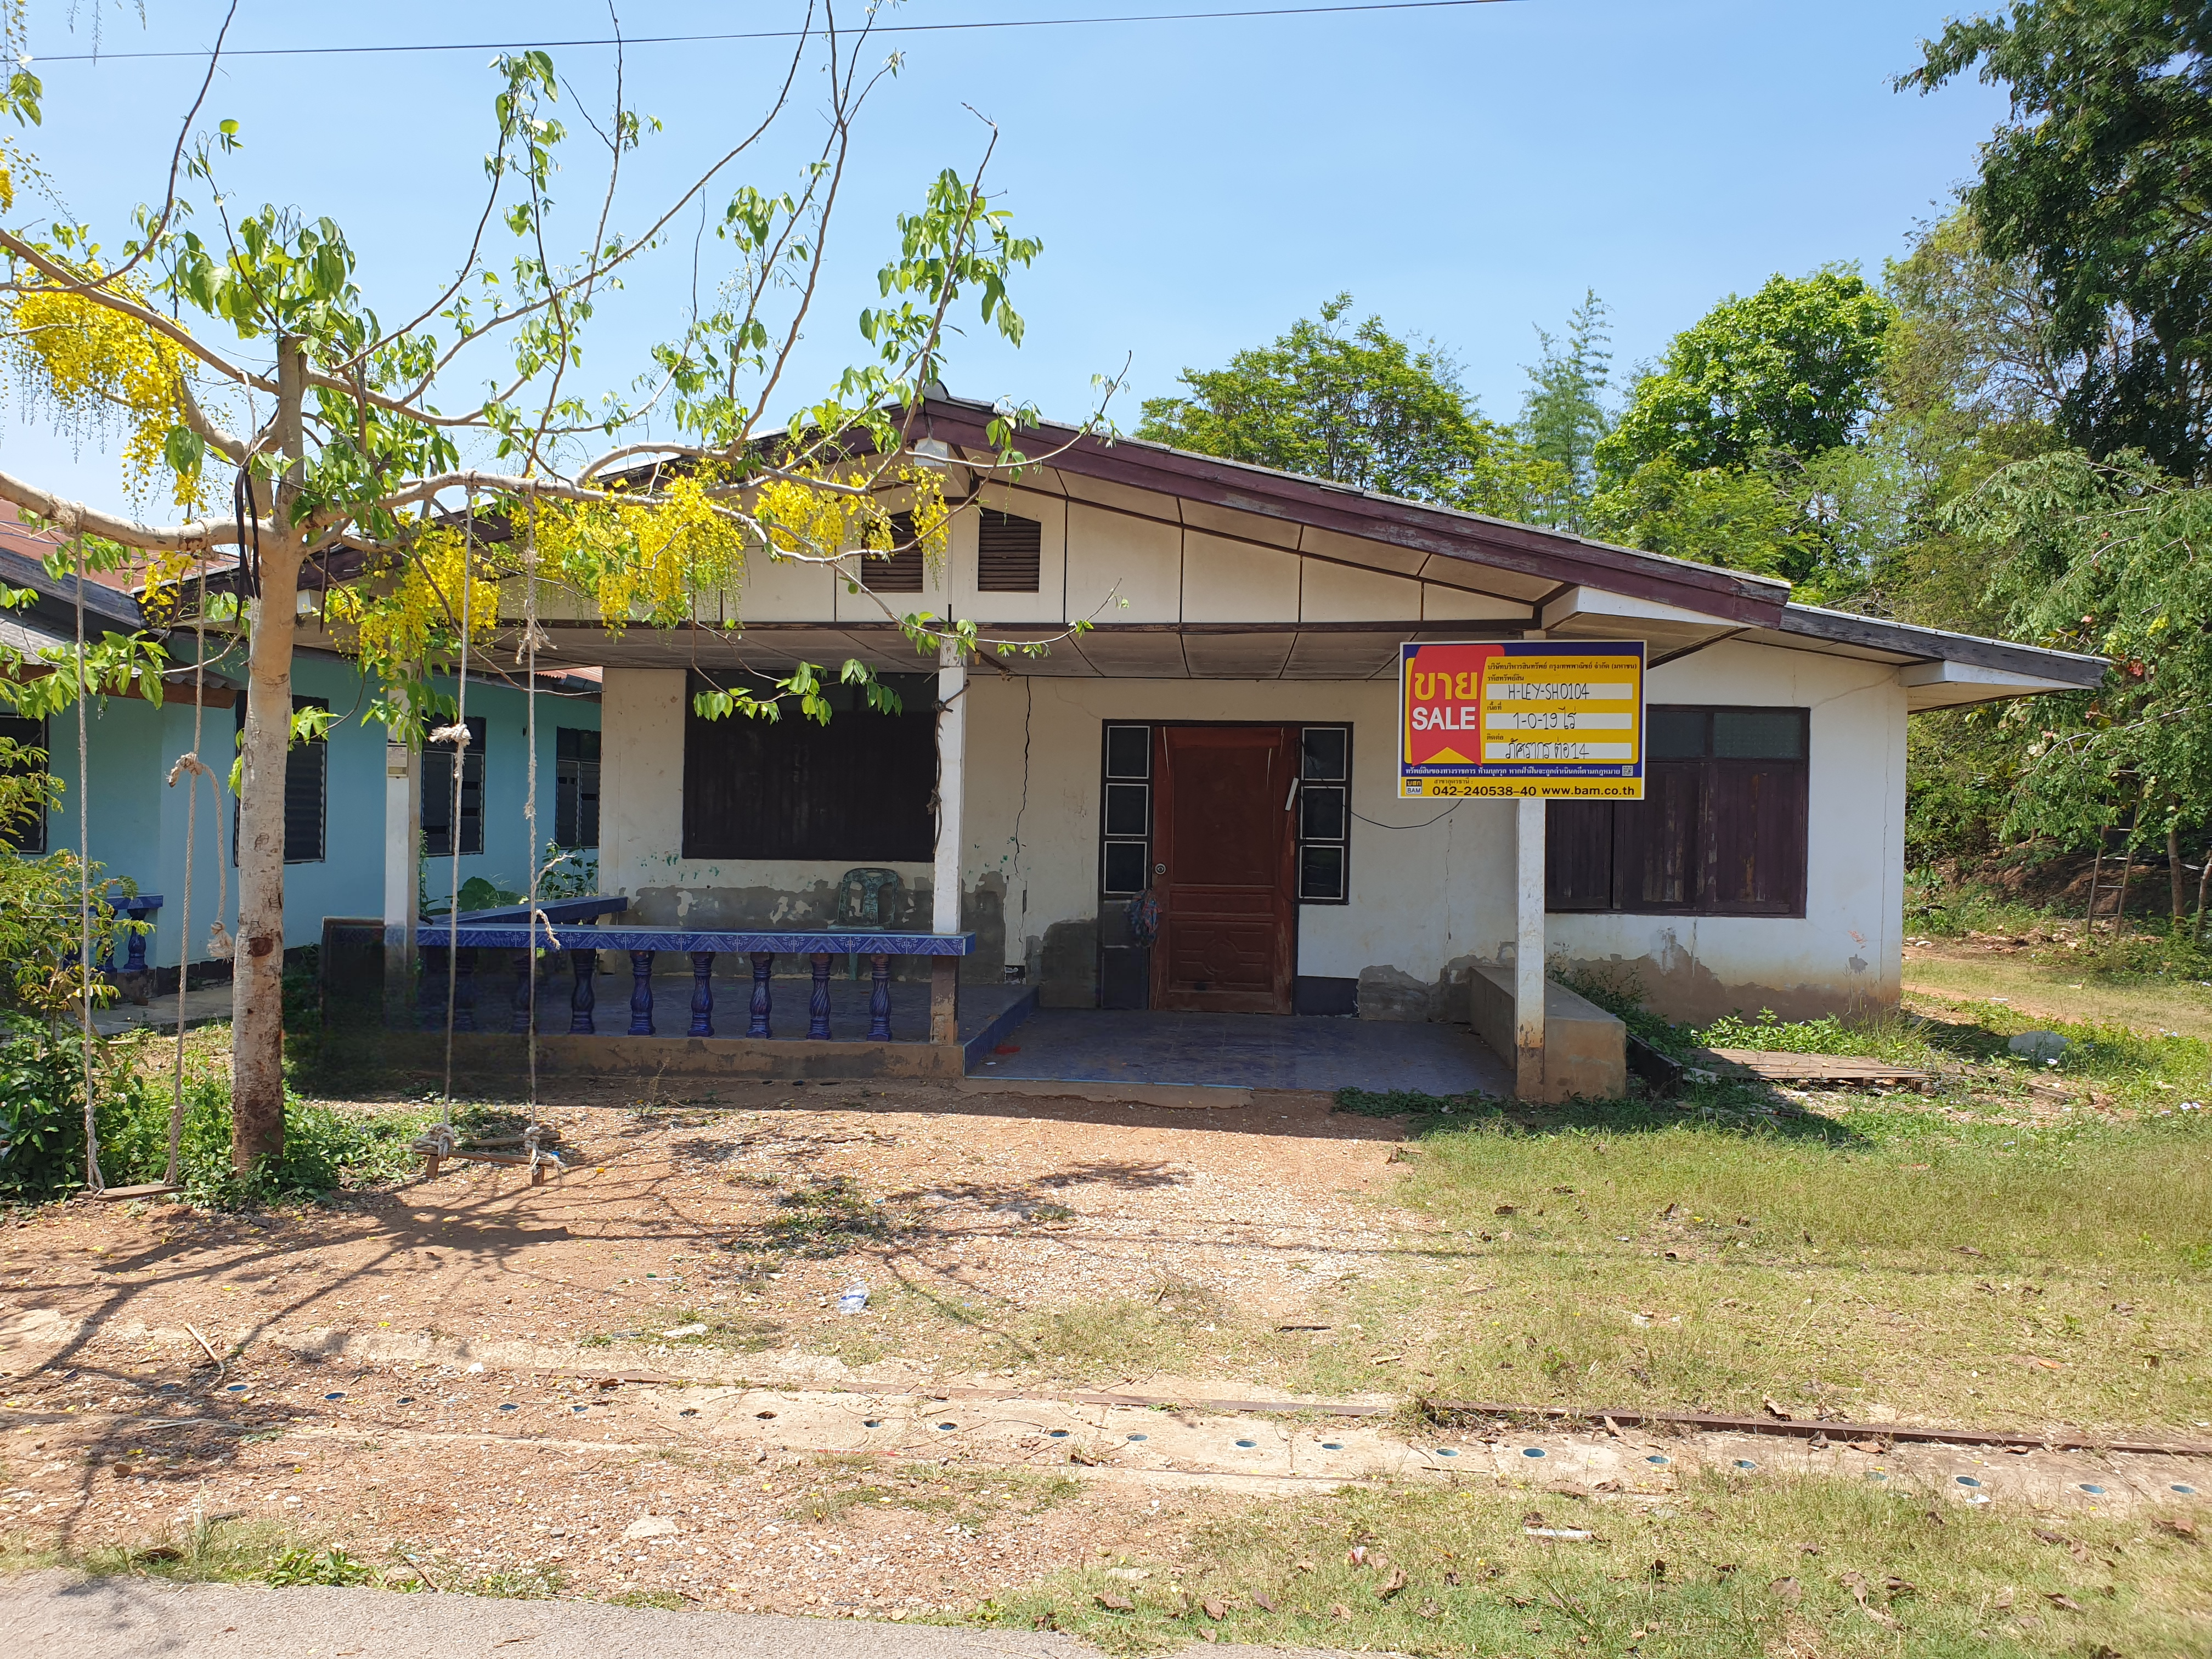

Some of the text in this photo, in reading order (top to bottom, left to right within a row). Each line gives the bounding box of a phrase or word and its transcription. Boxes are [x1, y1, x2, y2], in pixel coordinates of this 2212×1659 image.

[1549, 662, 1592, 672] กรุงเทพพาณิชย์
[1487, 673, 1524, 681] รหัสทรัพย์สิน
[1414, 672, 1477, 701] ขาย
[1487, 702, 1502, 710] เนื้อที่
[1412, 707, 1476, 730] SALE
[1513, 706, 1577, 730] 1-0-19 ไร่
[1477, 766, 1507, 776] ห้ามบุกรุก
[1432, 786, 1635, 796] 042-240538-40 www.bam.co.th
